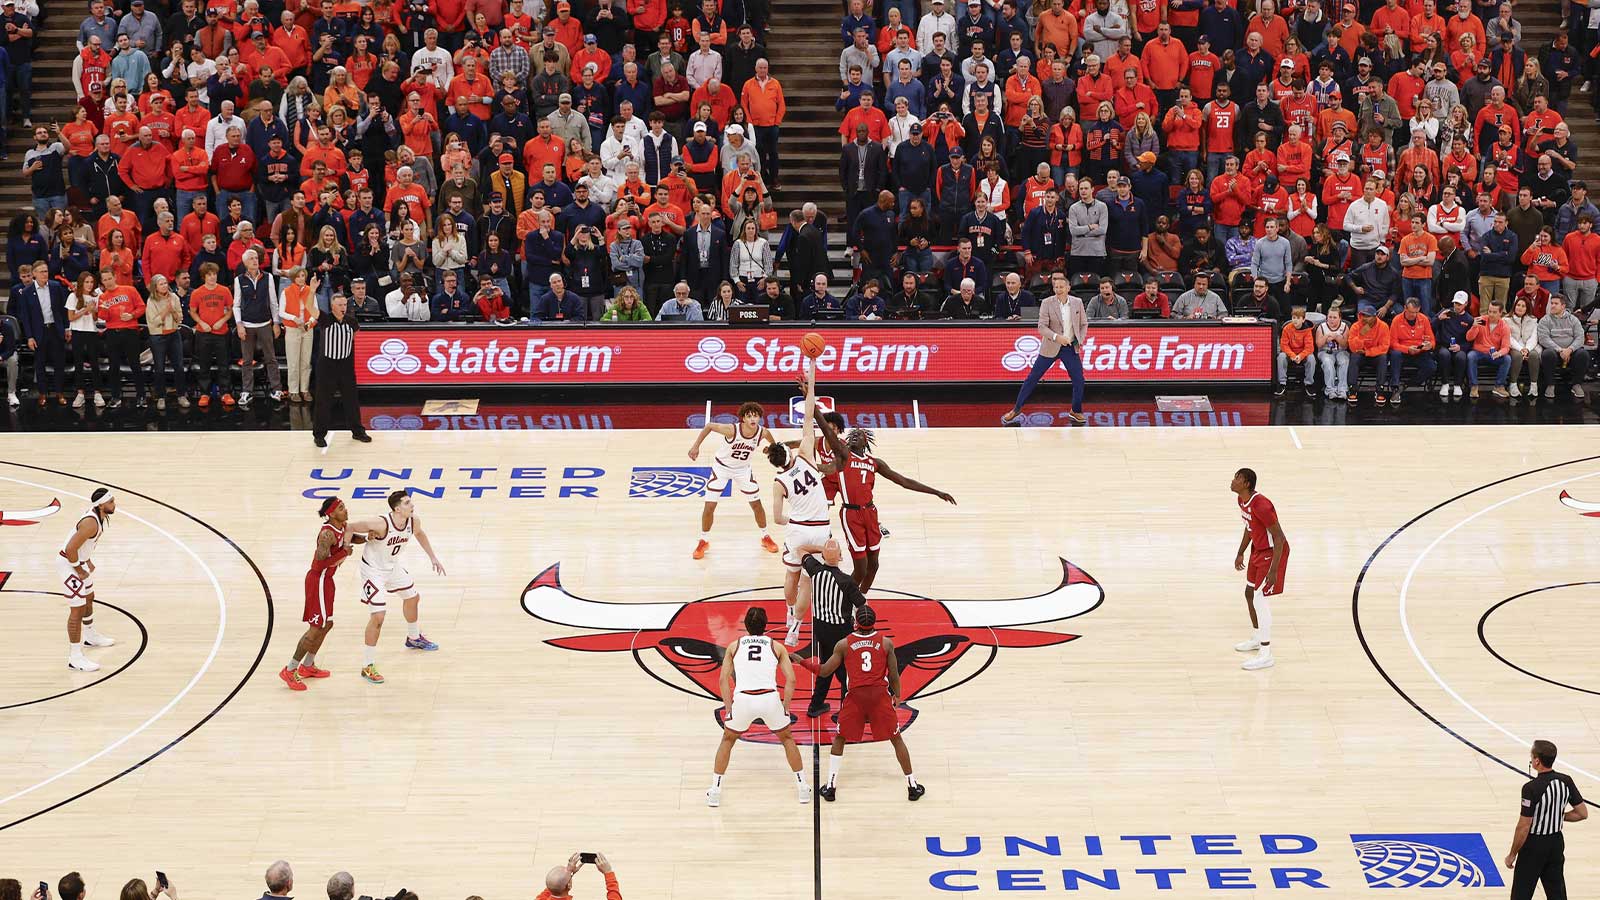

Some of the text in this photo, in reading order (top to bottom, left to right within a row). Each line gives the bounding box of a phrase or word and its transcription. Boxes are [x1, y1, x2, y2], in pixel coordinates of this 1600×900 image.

[673, 28, 682, 41] 18
[421, 56, 442, 64] ILLINOIS
[1216, 116, 1229, 128] 23
[739, 310, 759, 319] POSS.
[730, 450, 750, 461] 23
[850, 460, 875, 472] ALABAMA
[309, 467, 606, 481] UNITED
[860, 470, 868, 484] 7
[793, 470, 818, 496] 44
[302, 486, 600, 500] CENTER
[391, 544, 401, 556] 0
[748, 645, 762, 662] 2
[861, 651, 873, 672] 3
[925, 833, 1319, 857] UNITED
[928, 867, 1331, 891] CENTER
